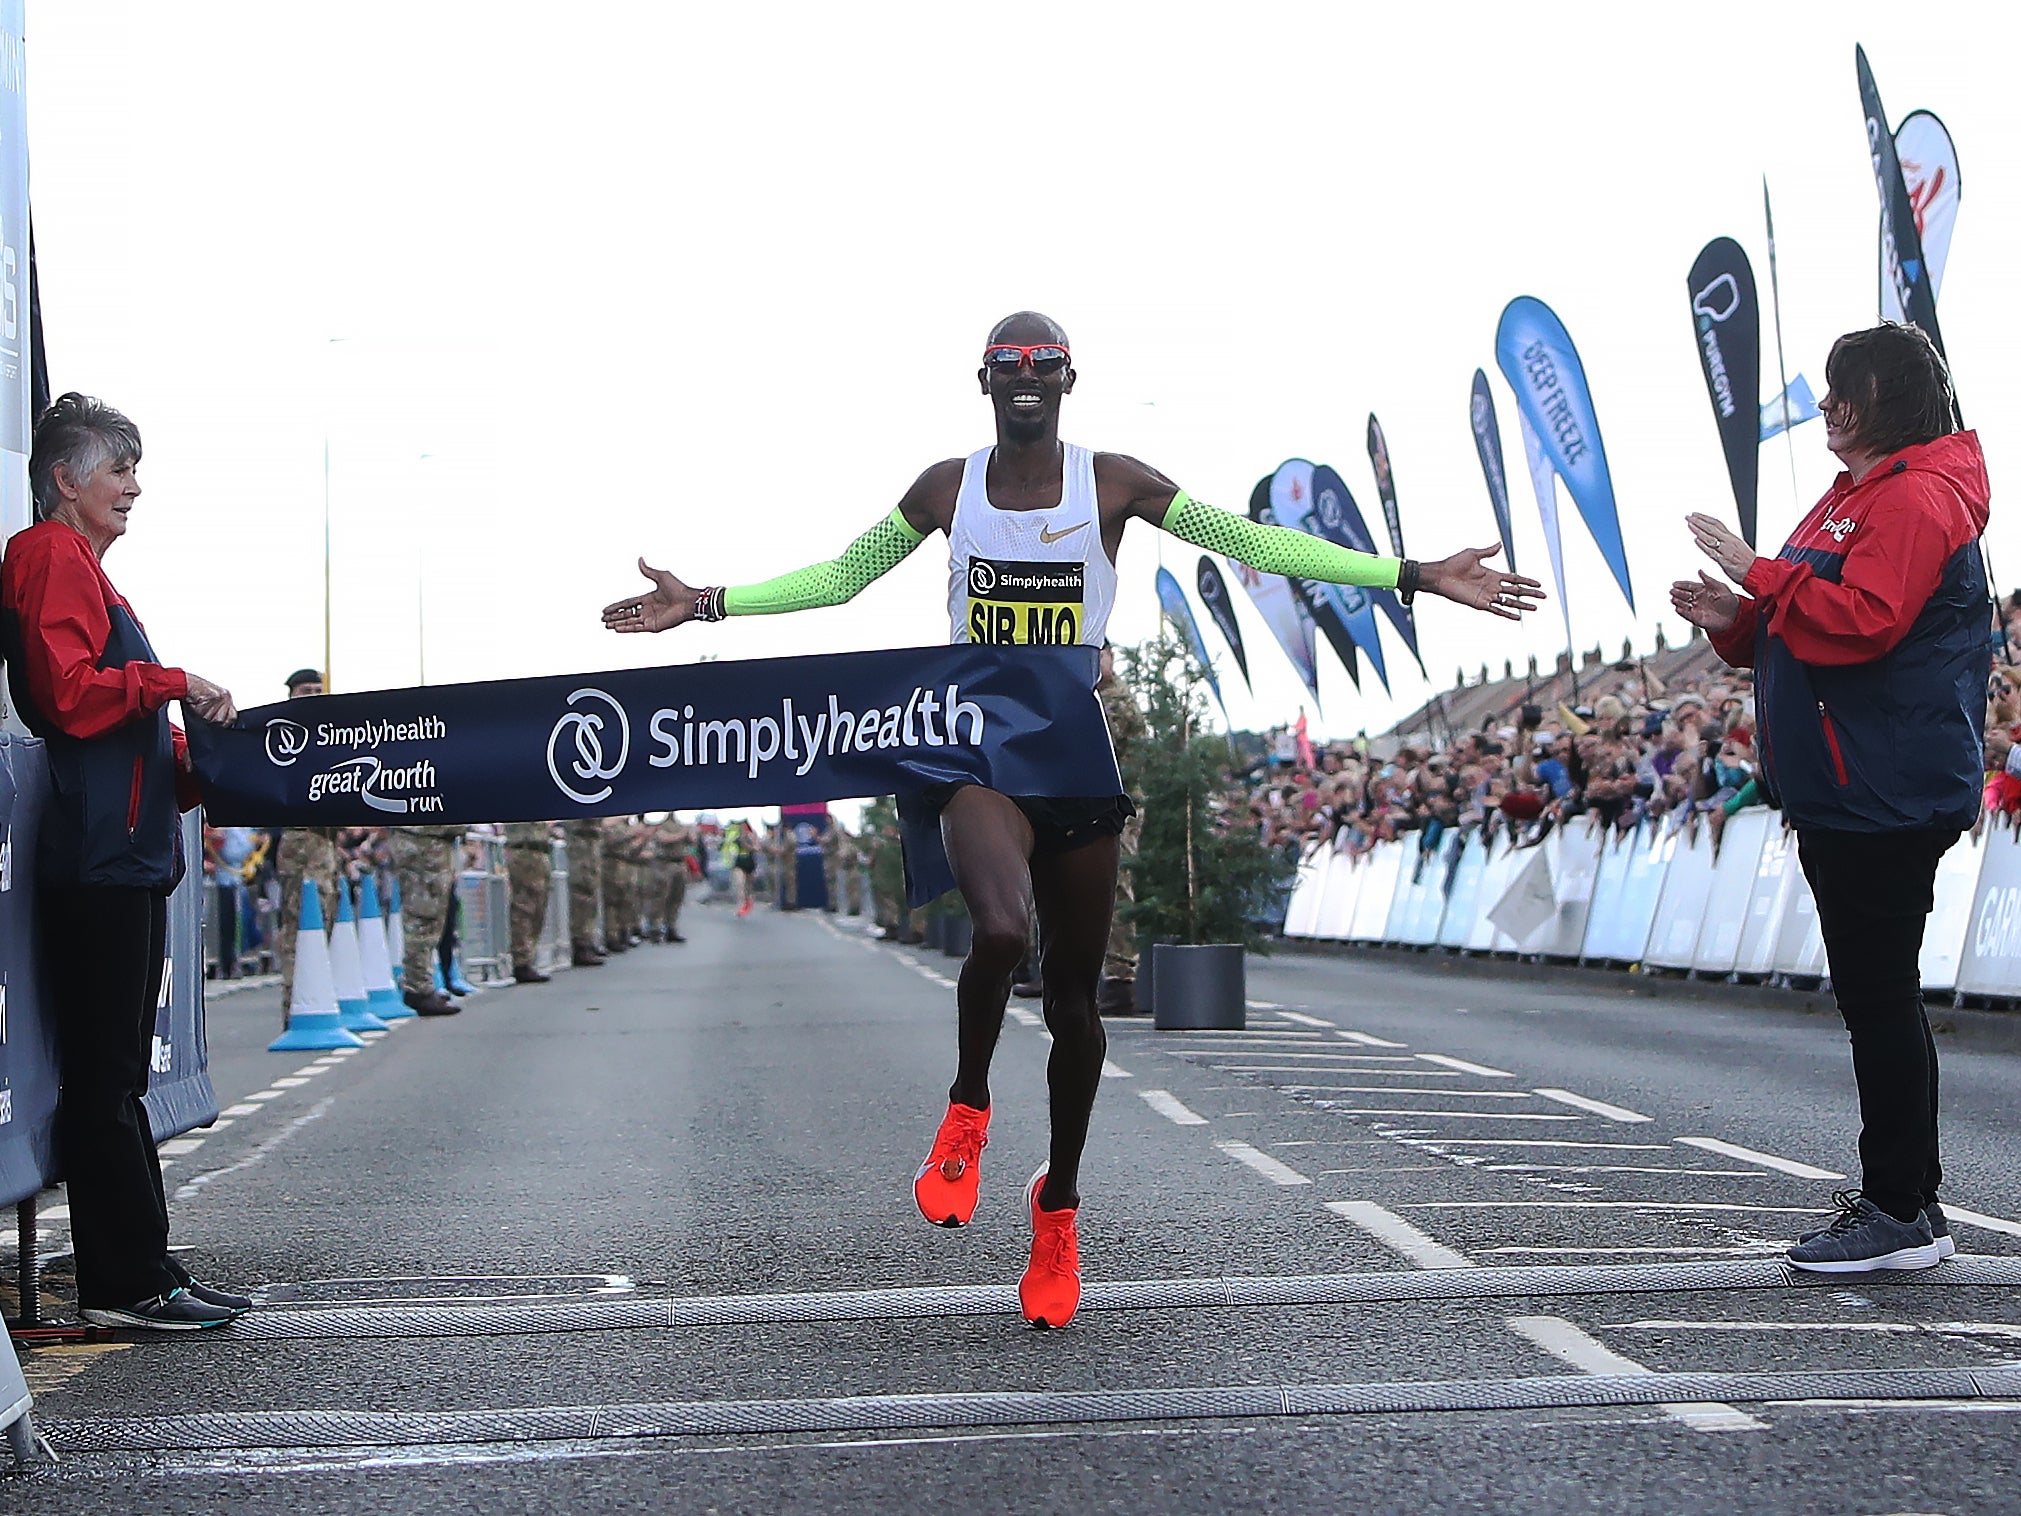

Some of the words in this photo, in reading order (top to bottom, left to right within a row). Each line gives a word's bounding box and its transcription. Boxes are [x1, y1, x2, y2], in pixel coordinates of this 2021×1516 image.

[1523, 339, 1558, 391] DEEP
[1542, 388, 1588, 465] FREEZE
[1000, 575, 1082, 590] Simplyhealth
[970, 602, 1016, 645] SIR
[1027, 606, 1076, 645] MO
[316, 714, 446, 751] Simplyhealth
[648, 684, 985, 779] Simplyhealth
[308, 765, 362, 802] great
[380, 759, 435, 791] north
[409, 796, 444, 813] run
